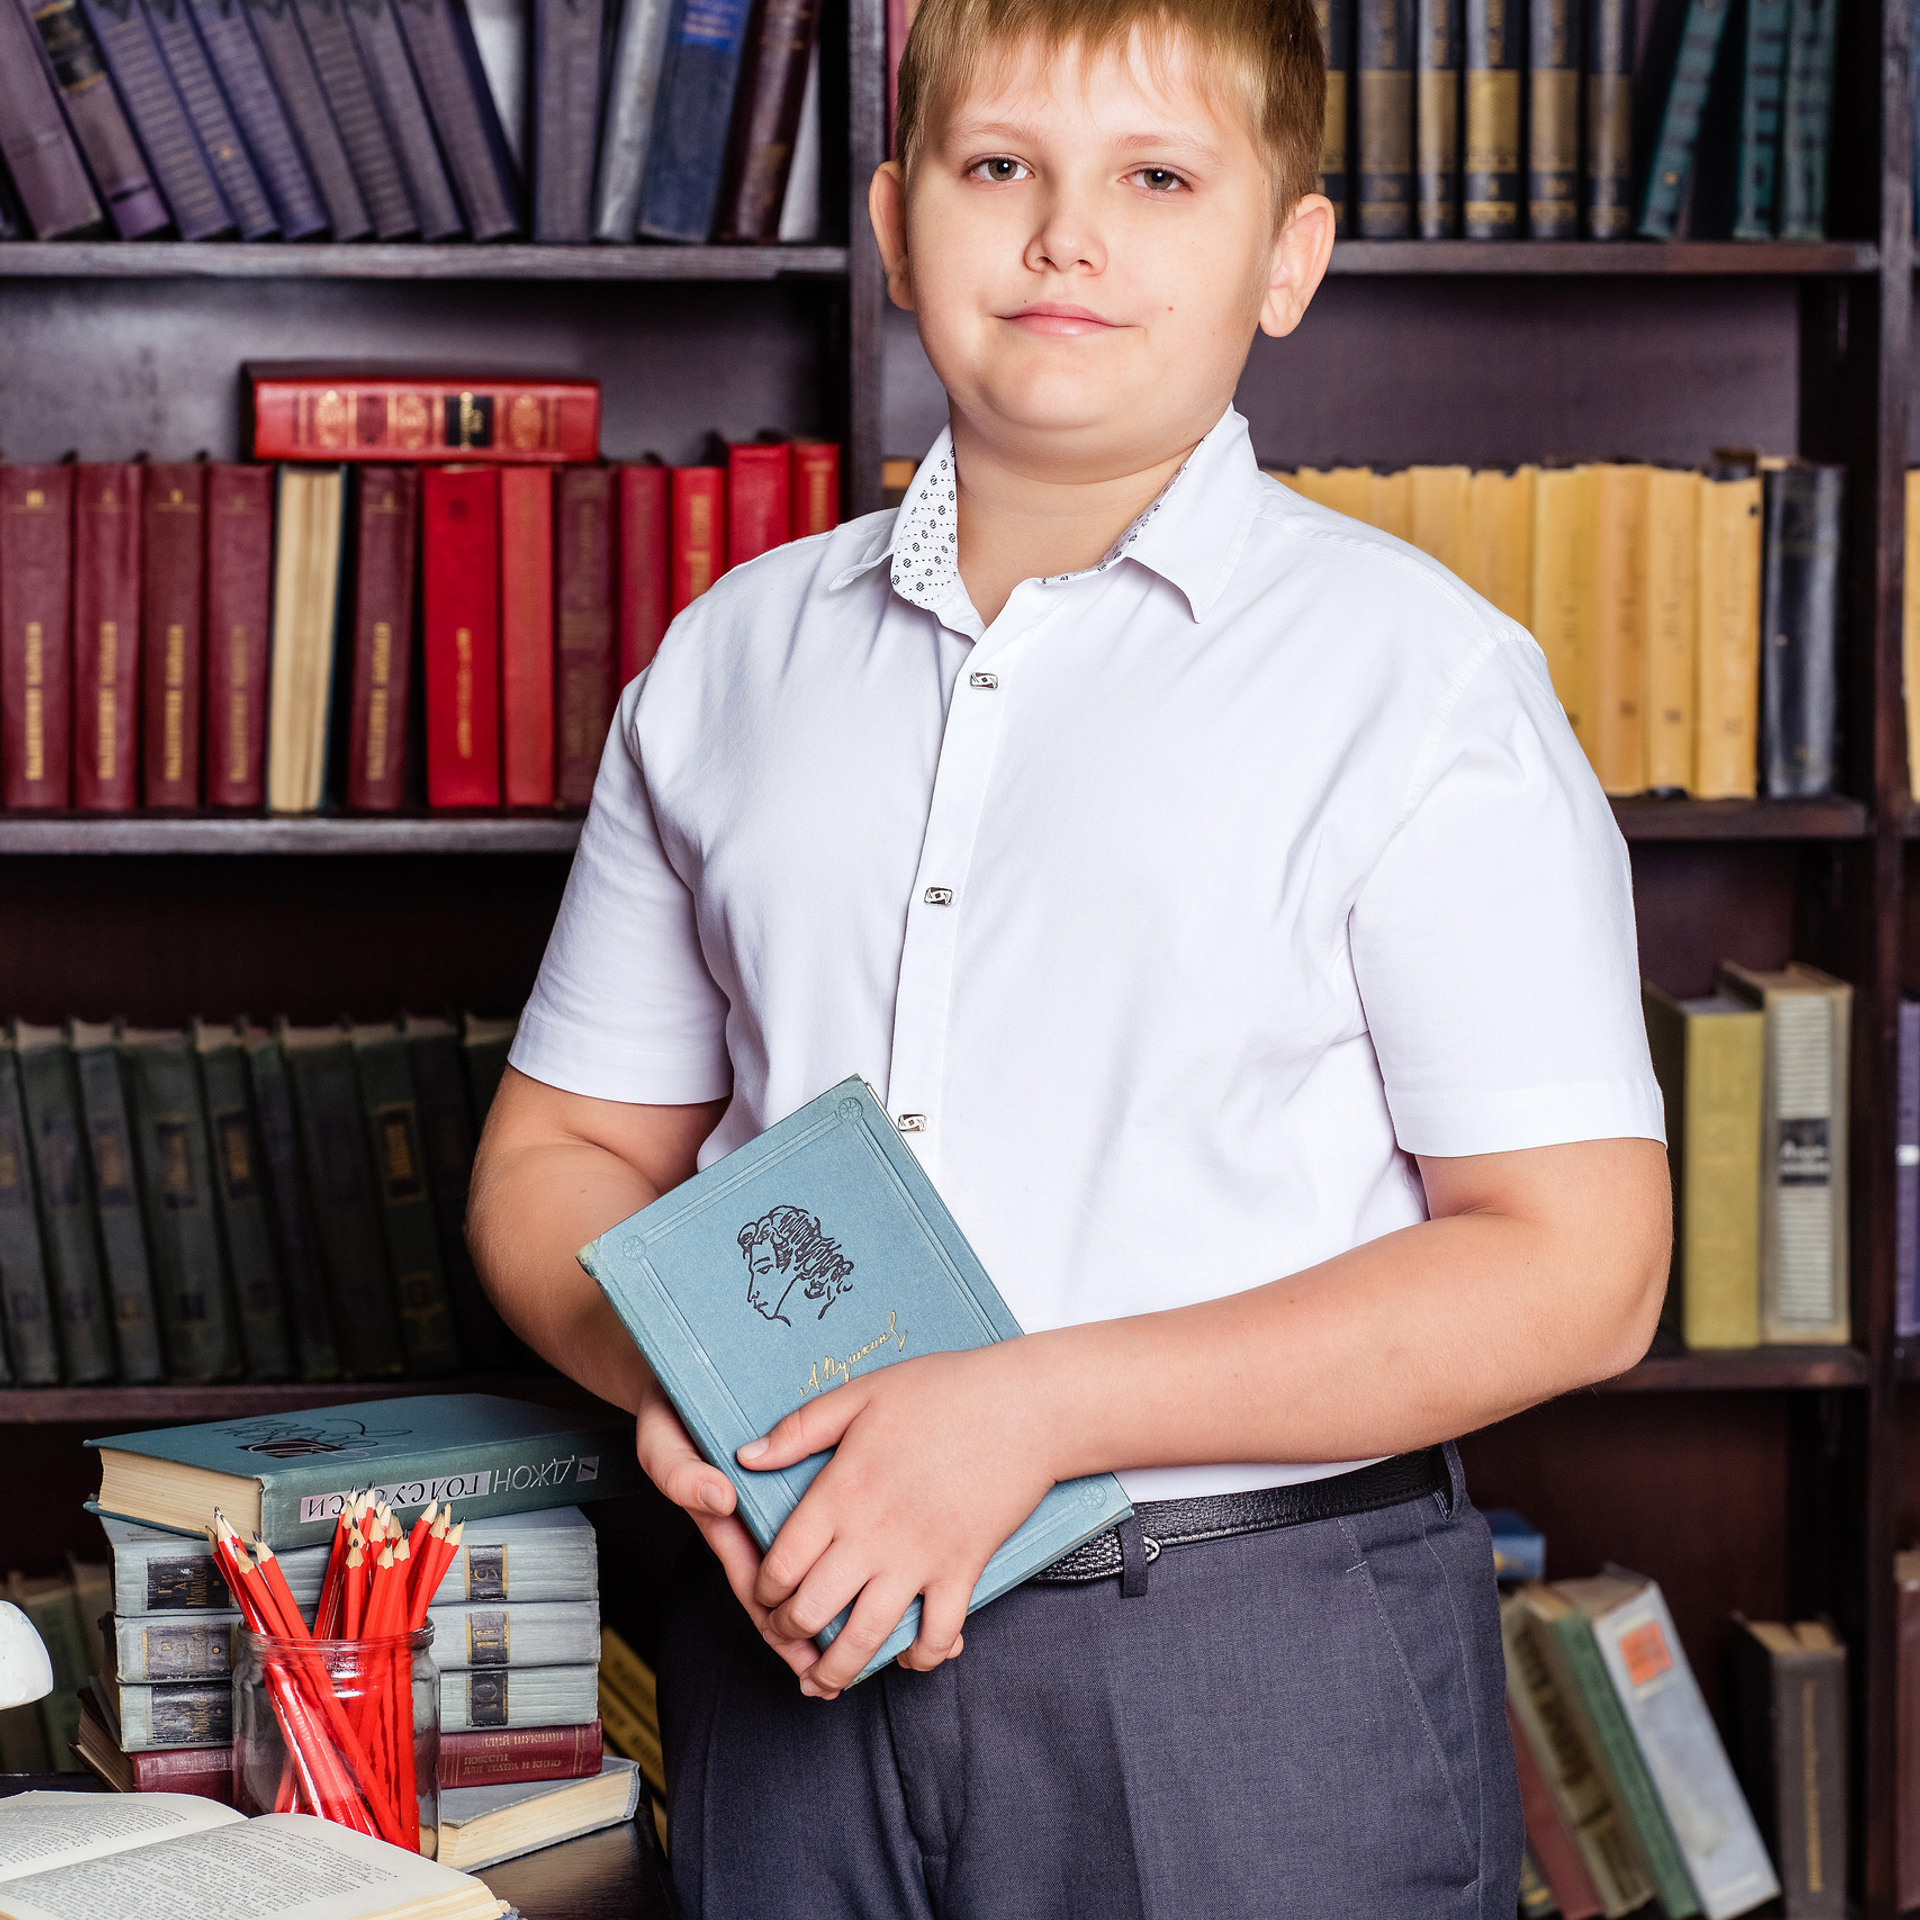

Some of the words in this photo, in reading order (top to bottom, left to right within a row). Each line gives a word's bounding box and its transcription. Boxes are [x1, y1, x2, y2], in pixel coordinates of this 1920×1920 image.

[494, 1455, 575, 1493] ДЖОН
[308, 1475, 480, 1517] ГОЛСУСИ
[474, 1566, 499, 1582] 9
[514, 1732, 563, 1746] ШУКШИН
[464, 1753, 509, 1765] ПОВЕСТИ
[532, 1759, 561, 1769] КИНО
